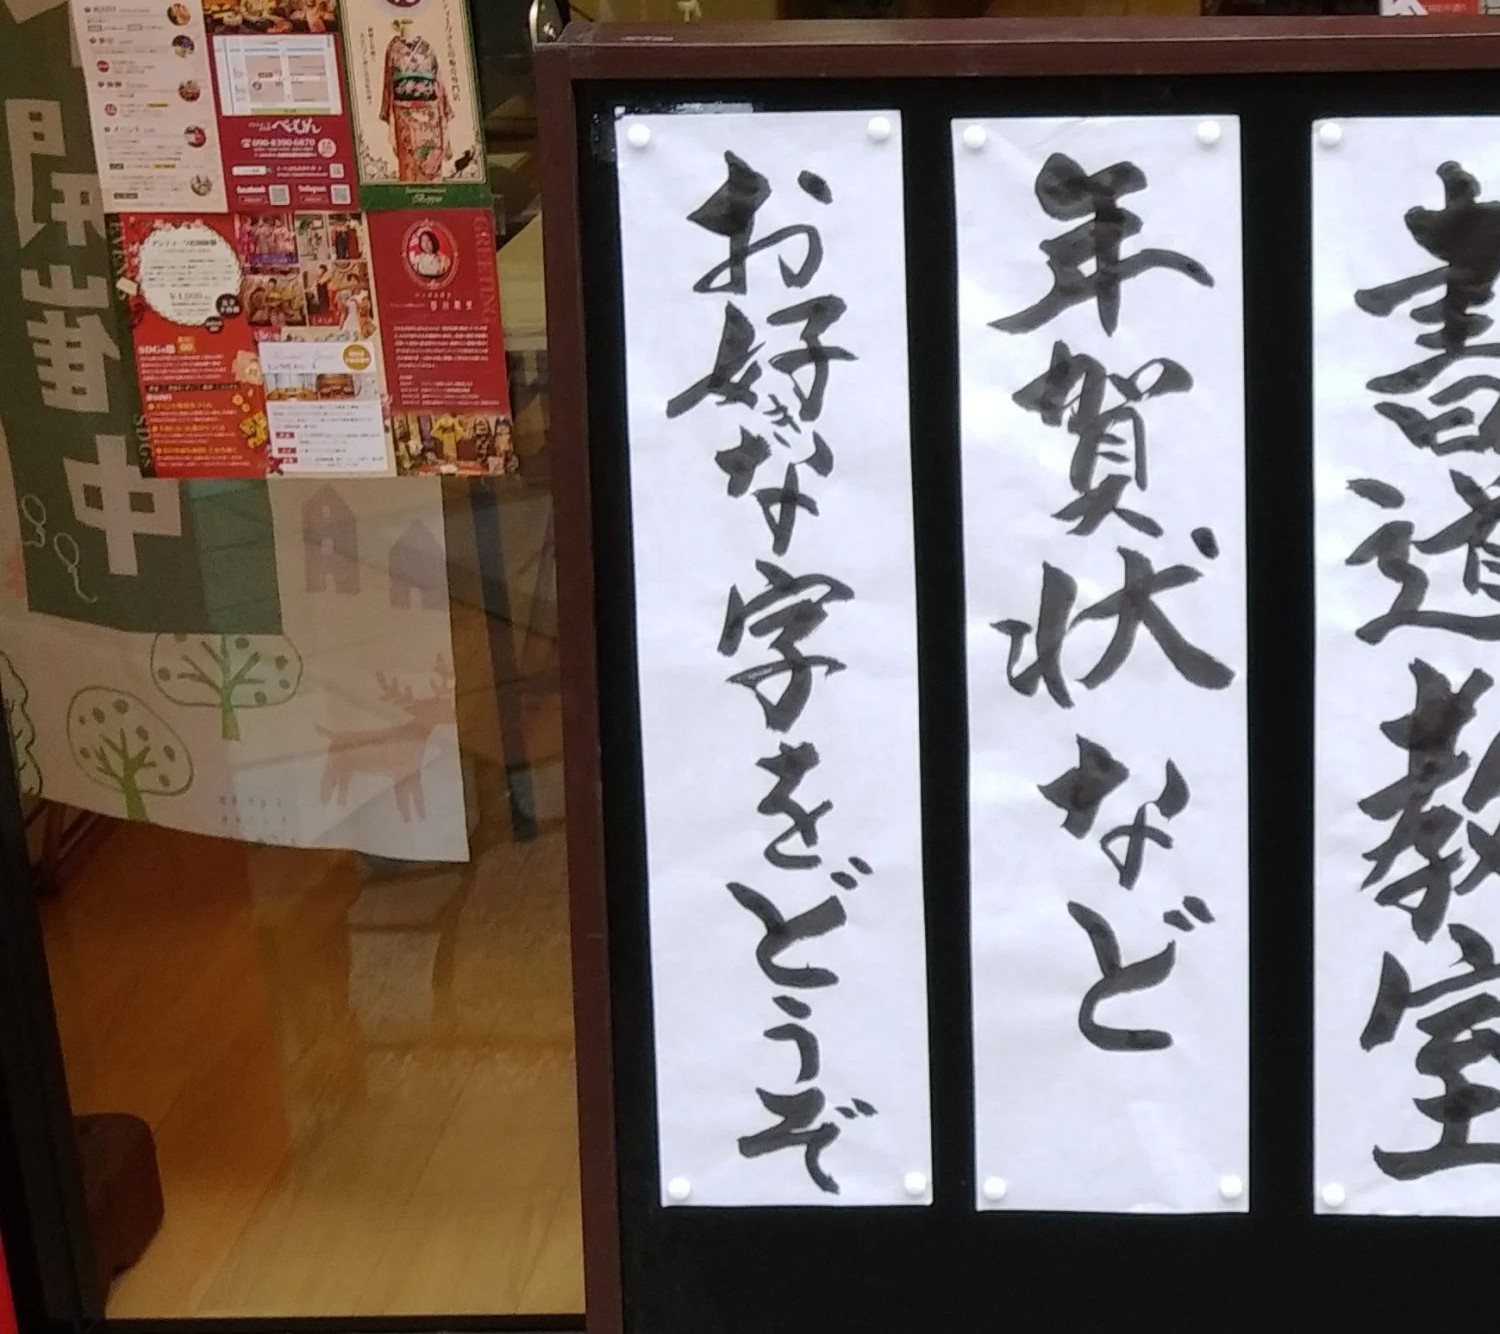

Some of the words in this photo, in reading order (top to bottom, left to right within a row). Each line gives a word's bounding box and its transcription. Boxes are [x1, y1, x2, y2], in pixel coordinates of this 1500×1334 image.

[988, 151, 1237, 1051] 年賀状など
